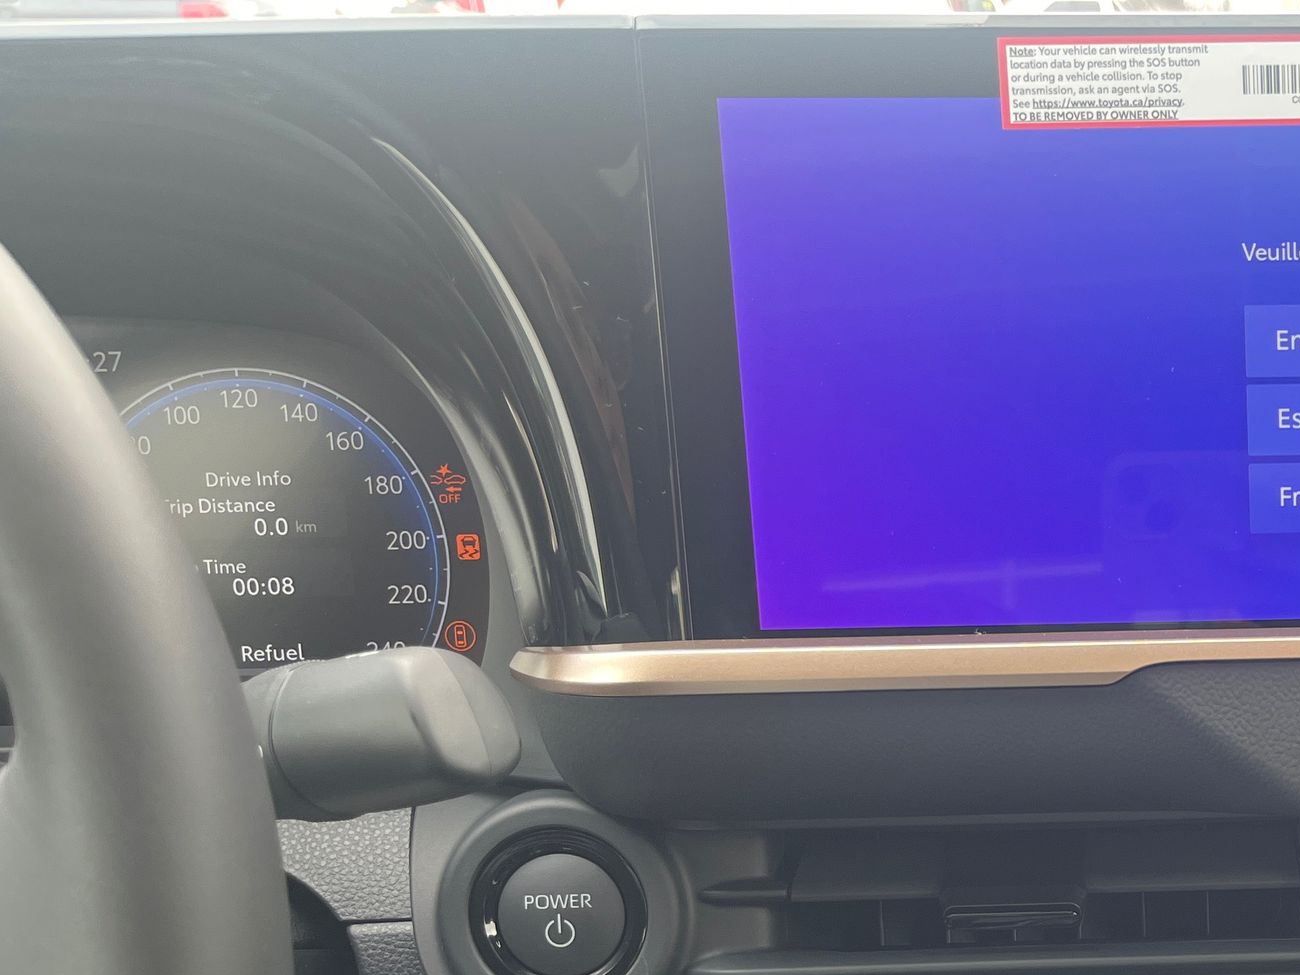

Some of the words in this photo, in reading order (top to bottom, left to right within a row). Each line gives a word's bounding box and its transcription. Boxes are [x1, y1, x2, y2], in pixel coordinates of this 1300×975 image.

[1009, 47, 1036, 57] Note:
[1038, 46, 1061, 56] Your
[1063, 46, 1097, 55] vehicle
[1099, 47, 1116, 55] can
[1119, 44, 1166, 56] wirelessly
[1168, 44, 1208, 54] transmit
[1010, 60, 1048, 69] location
[1050, 59, 1072, 69] data
[1074, 59, 1085, 70] by
[1087, 58, 1126, 70] pressing
[1129, 58, 1144, 68] the
[1147, 58, 1166, 67] SOS
[1168, 58, 1200, 67] button
[1011, 74, 1021, 82] or
[1023, 73, 1055, 84] during
[1058, 74, 1063, 82] a
[1066, 72, 1099, 81] vehicle
[1102, 72, 1144, 80] collision.
[1147, 71, 1158, 80] To
[1161, 72, 1182, 82] stop
[1012, 85, 1076, 96] transmission,
[1078, 85, 1094, 94] ask
[1112, 85, 1140, 96] agent
[1142, 84, 1155, 93] via
[1158, 84, 1181, 93] SOS.
[1013, 99, 1030, 108] See
[1013, 112, 1027, 121] TO
[1030, 112, 1042, 121] BE
[1044, 112, 1094, 120] REMOVED
[1096, 111, 1108, 120] BY
[1110, 110, 1149, 120] OWNER
[1151, 110, 1178, 120] ONLY
[220, 388, 258, 408] 120
[163, 405, 200, 425] 100
[280, 402, 318, 422] 140
[326, 430, 364, 452] 160
[205, 472, 251, 488] Drive
[256, 471, 292, 487] Info
[364, 475, 403, 496] 180
[166, 499, 193, 518] rip
[199, 498, 276, 514] Distance
[438, 494, 462, 504] OFF
[254, 518, 288, 536] 0.0
[296, 520, 316, 532] km
[386, 530, 426, 550] 200
[203, 559, 246, 574] Time
[232, 577, 295, 596] 00:08
[387, 584, 428, 604] 220
[241, 643, 304, 662] Refuel
[524, 894, 592, 910] POWER
